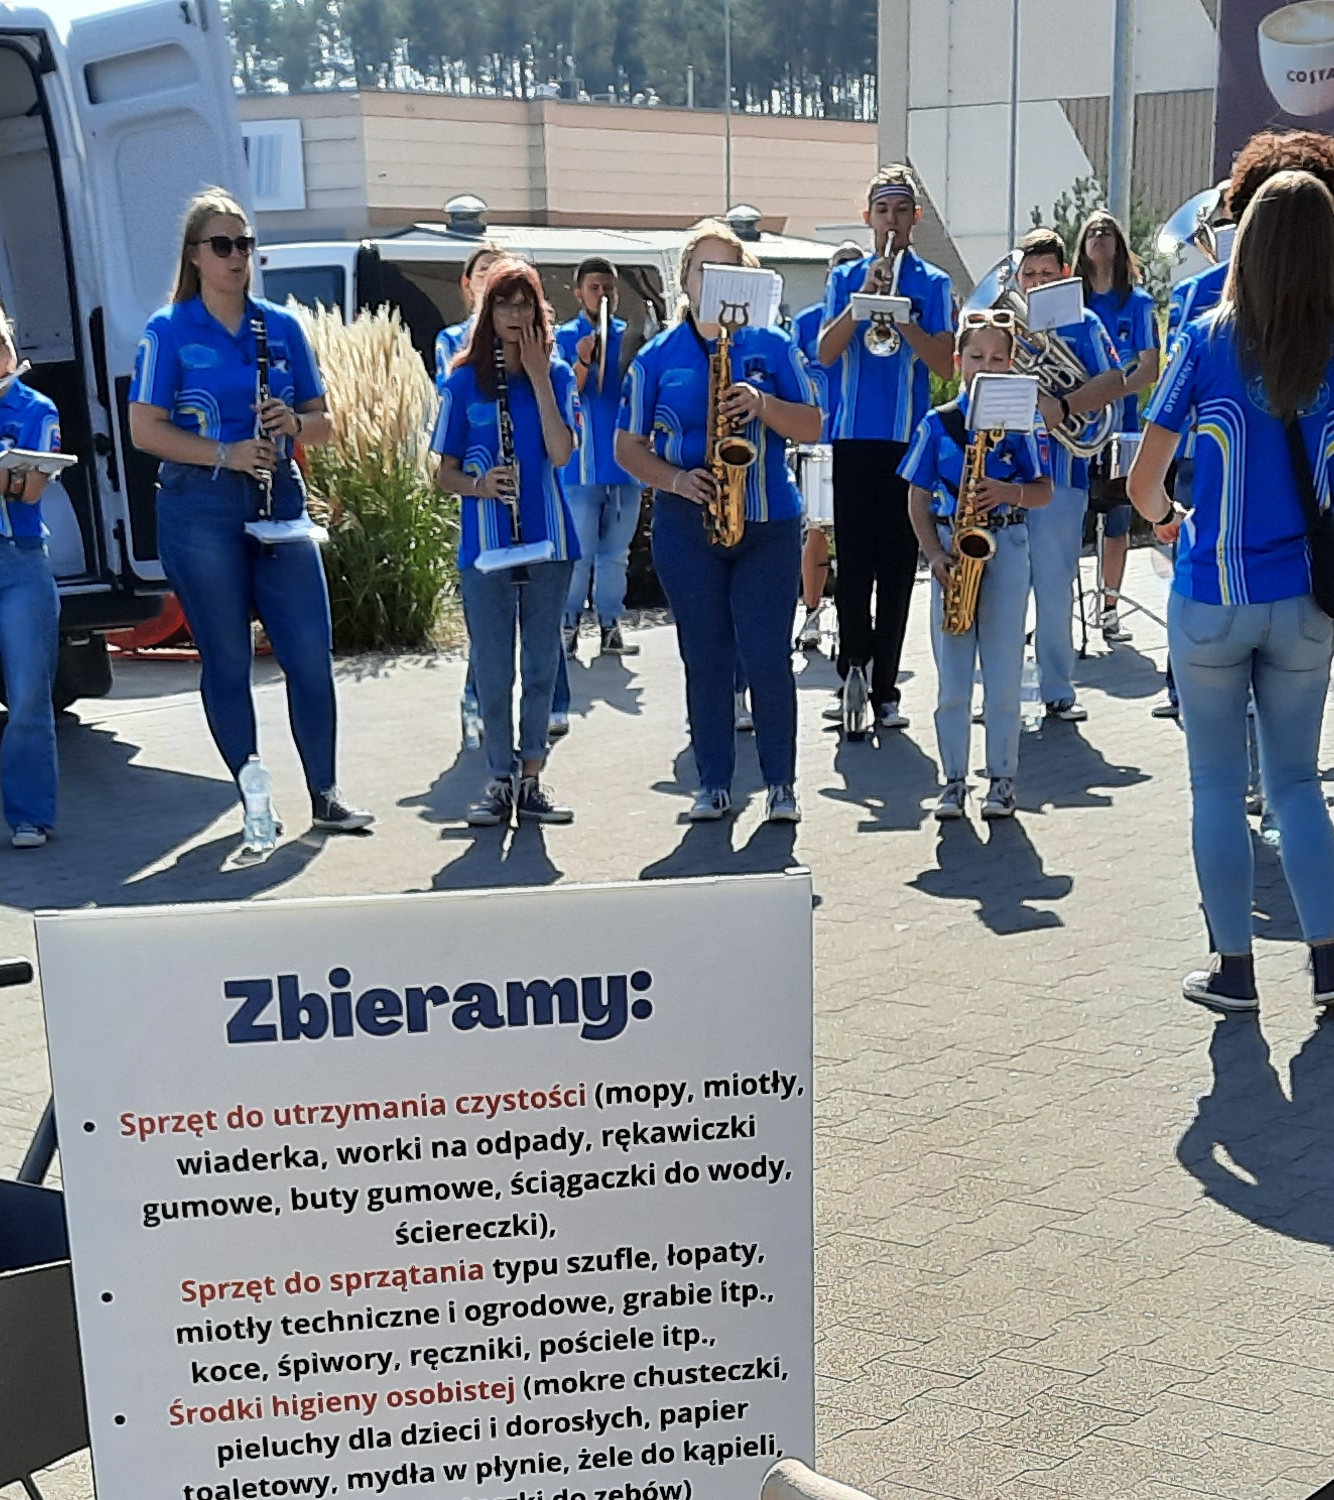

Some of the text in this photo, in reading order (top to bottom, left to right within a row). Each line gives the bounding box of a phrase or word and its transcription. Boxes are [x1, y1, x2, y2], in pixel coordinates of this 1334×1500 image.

[1163, 358, 1195, 414] DYRYGENT
[223, 967, 654, 1045] Zbieramy:
[120, 1069, 804, 1143] Sprzęt do utrzymania czystości (mopy, miotły,
[175, 1113, 756, 1176] wiaderka, worki na odpady, rękawiczki
[142, 1154, 792, 1228] gumowe, buty gumowe, ściągaczki do wody,
[395, 1211, 556, 1246] ściereczki),
[181, 1241, 765, 1309] Sprzęt do sprzątania typu szufle, łopaty,
[176, 1279, 774, 1345] miotły techniczne i ogrodowe, grabie itp.,
[191, 1323, 716, 1385] koce, śpiwory, ręczniki, pościele itp.,
[169, 1355, 789, 1426] Środki higieny osobistej (mokre chusteczki,
[216, 1399, 750, 1469] pieluchy dla dzieci i dorosłych, papier
[346, 1462, 435, 1494] mydła
[442, 1463, 468, 1482] w
[475, 1451, 570, 1485] płynie,
[577, 1445, 634, 1471] żele
[640, 1441, 675, 1465] do
[683, 1433, 784, 1467] kąpieli,
